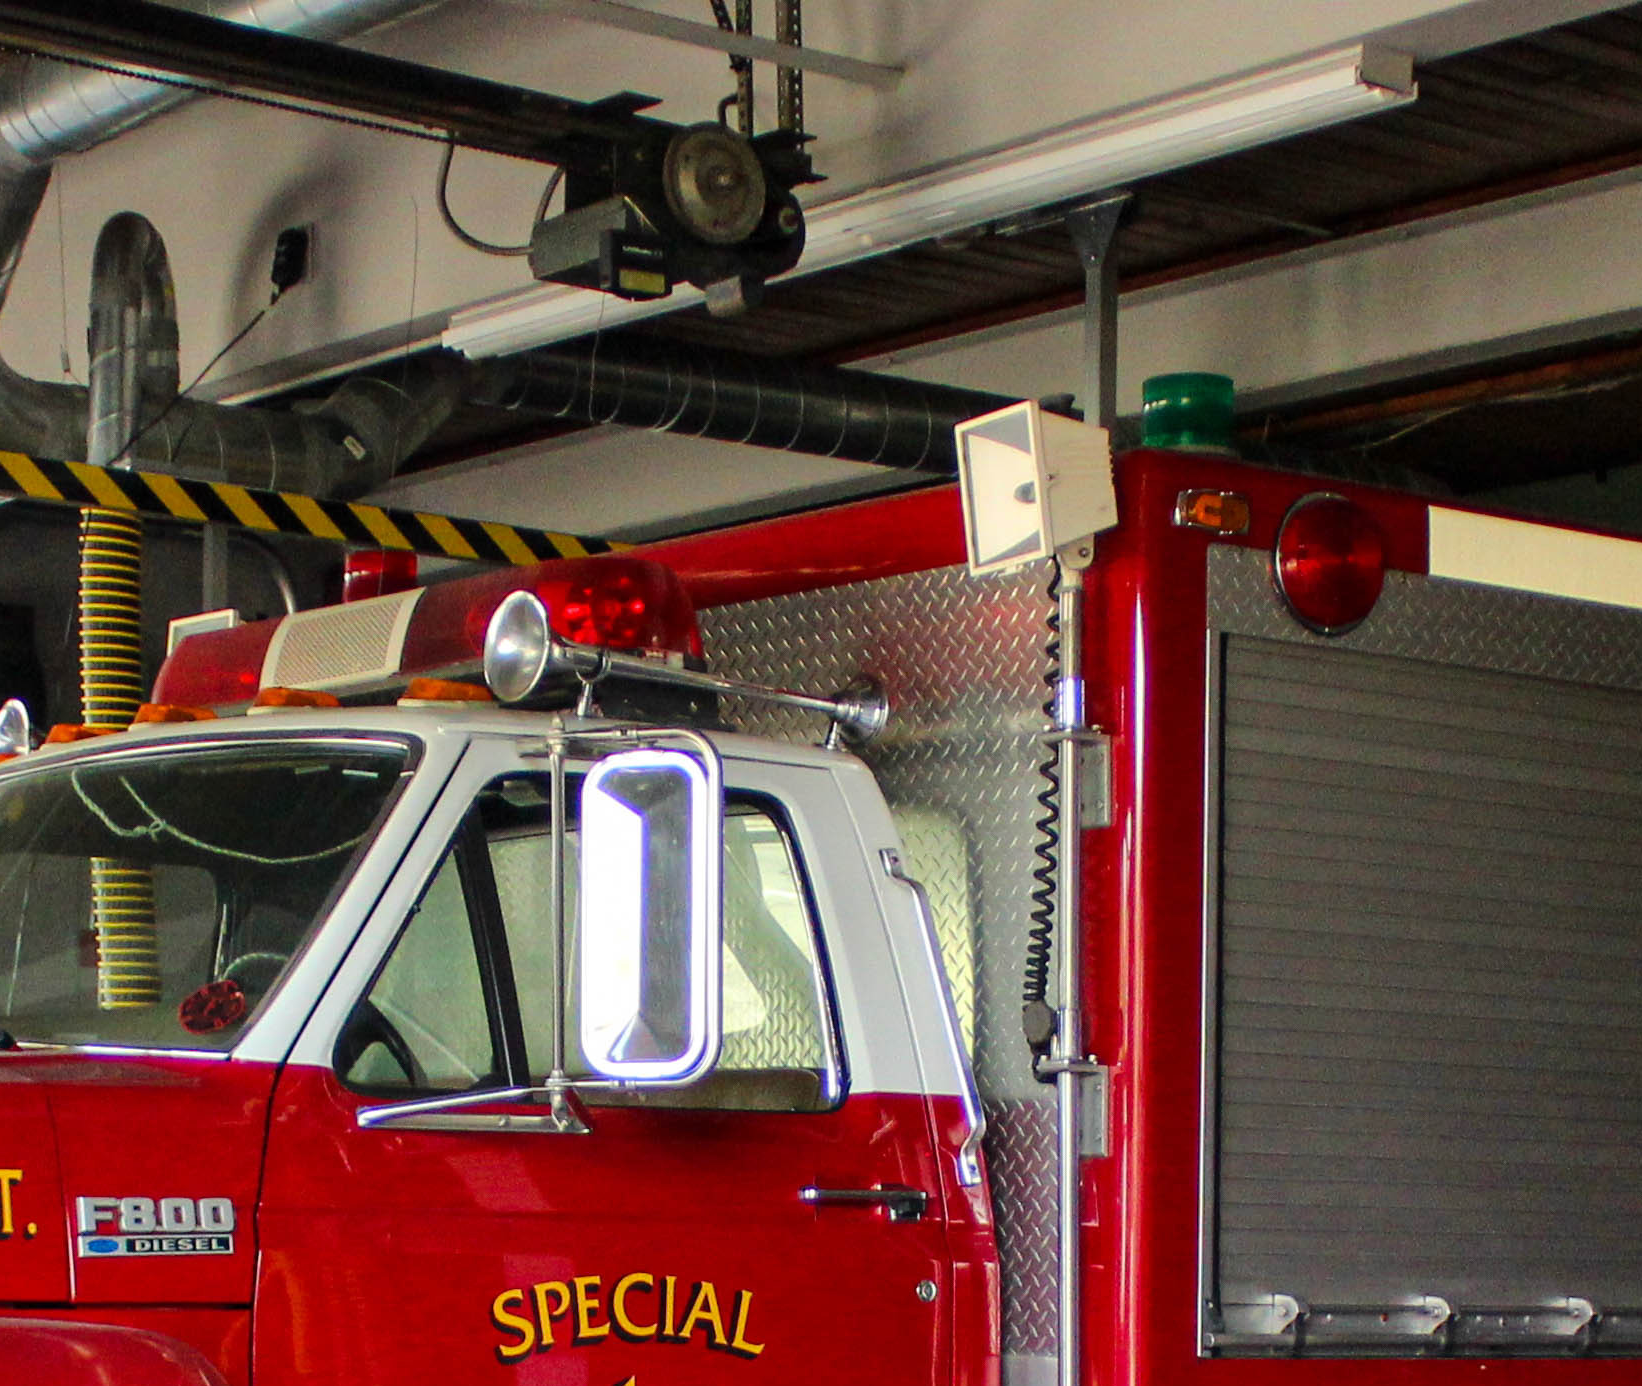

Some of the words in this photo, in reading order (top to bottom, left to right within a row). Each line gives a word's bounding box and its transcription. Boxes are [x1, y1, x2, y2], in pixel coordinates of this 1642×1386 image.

[76, 1197, 235, 1233] F800
[134, 1238, 225, 1252] DIESEL
[492, 1271, 765, 1358] SPECIAL
